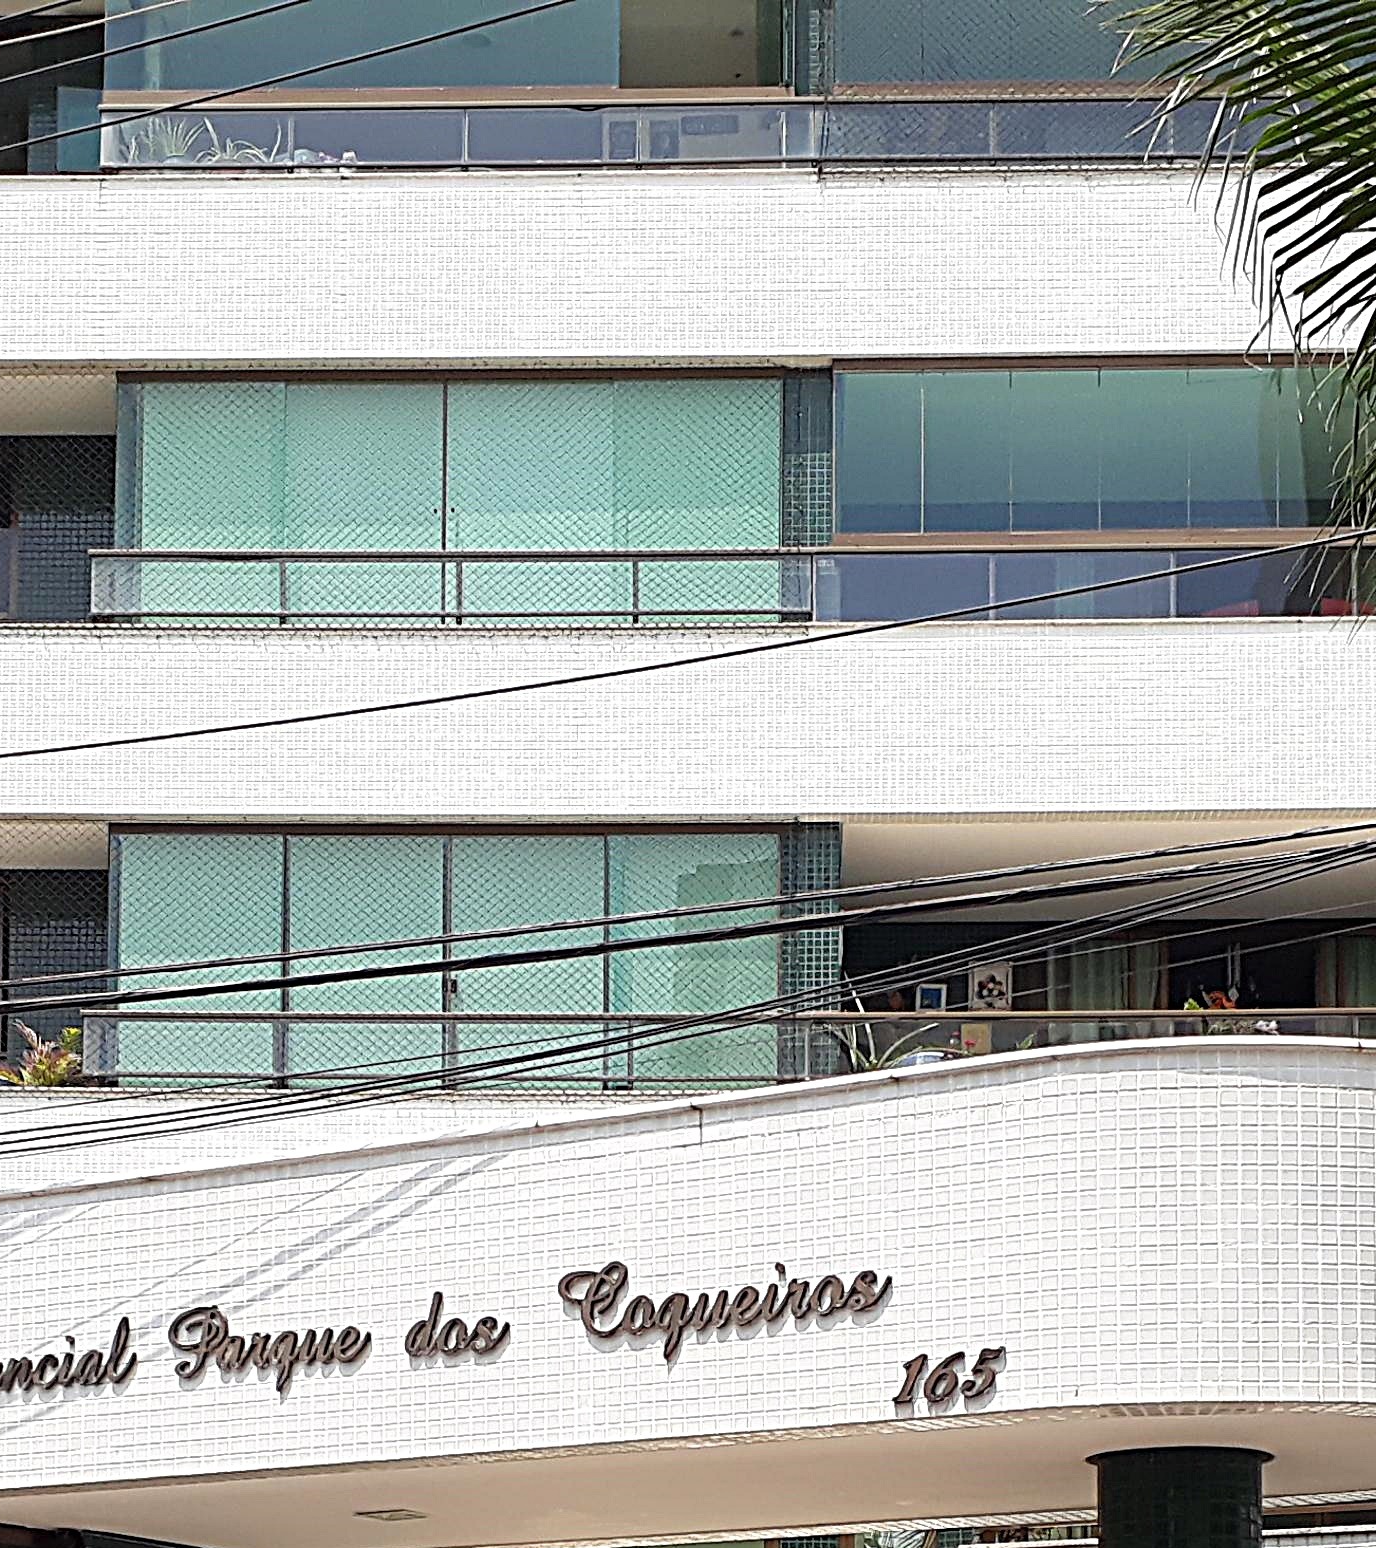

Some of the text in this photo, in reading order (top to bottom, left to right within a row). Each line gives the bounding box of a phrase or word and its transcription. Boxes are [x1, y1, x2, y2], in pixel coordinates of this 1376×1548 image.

[167, 1304, 373, 1394] Parque
[404, 1290, 511, 1358] dos
[557, 1260, 893, 1363] Coqueiros
[891, 1345, 1006, 1404] 165
